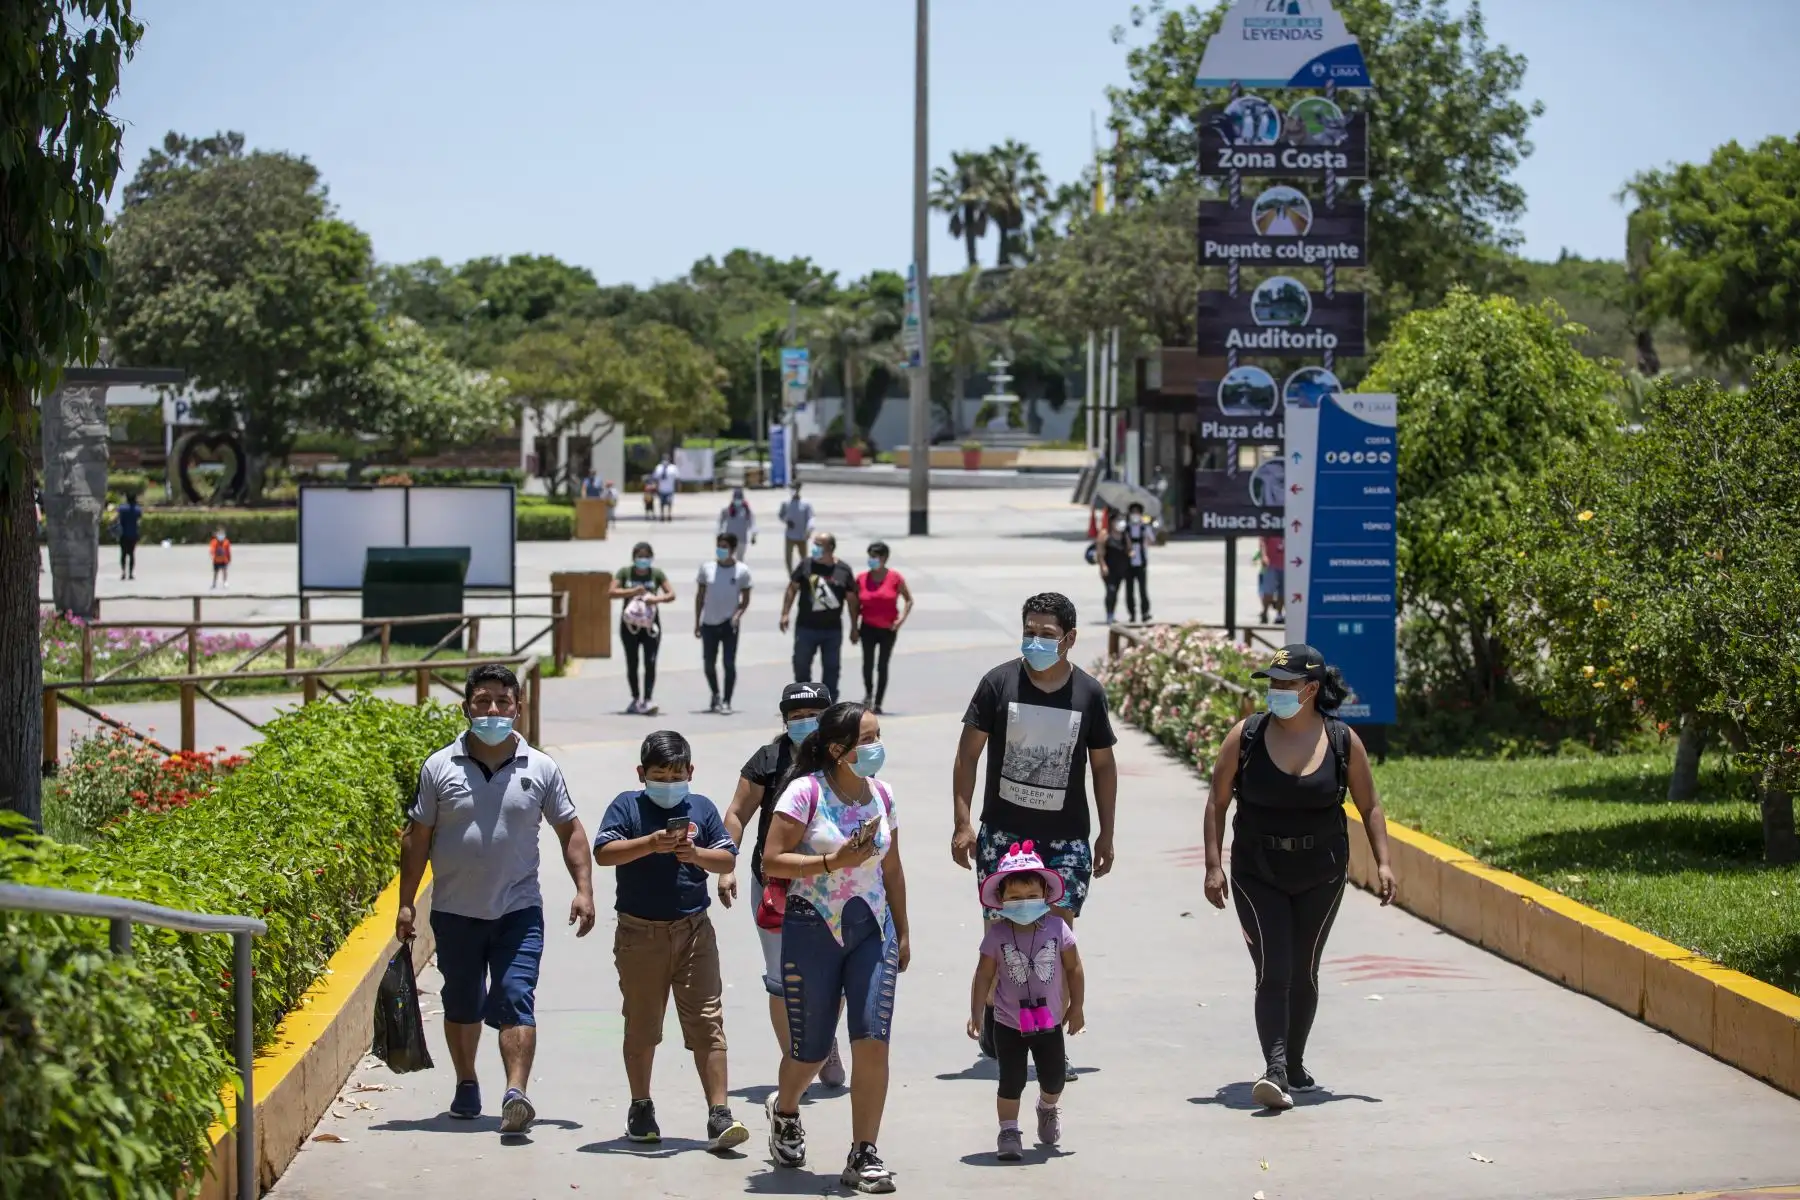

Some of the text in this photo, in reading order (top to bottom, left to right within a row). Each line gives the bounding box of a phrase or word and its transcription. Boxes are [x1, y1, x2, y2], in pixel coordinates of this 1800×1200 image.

[1242, 28, 1323, 41] LEYENDAS
[1330, 67, 1361, 77] LIMA
[1218, 147, 1348, 169] Zona Costa
[1204, 239, 1360, 262] Puente colgante
[1225, 327, 1338, 349] Auditorio
[1202, 422, 1248, 439] Plaza
[1252, 422, 1274, 439] de
[1363, 486, 1392, 495] SALIDA
[1202, 512, 1257, 529] Huaca
[1329, 558, 1391, 567] INTERNACIONAL
[1009, 784, 1054, 799] NO SLEEP IN
[1014, 794, 1047, 805] THE CITY
